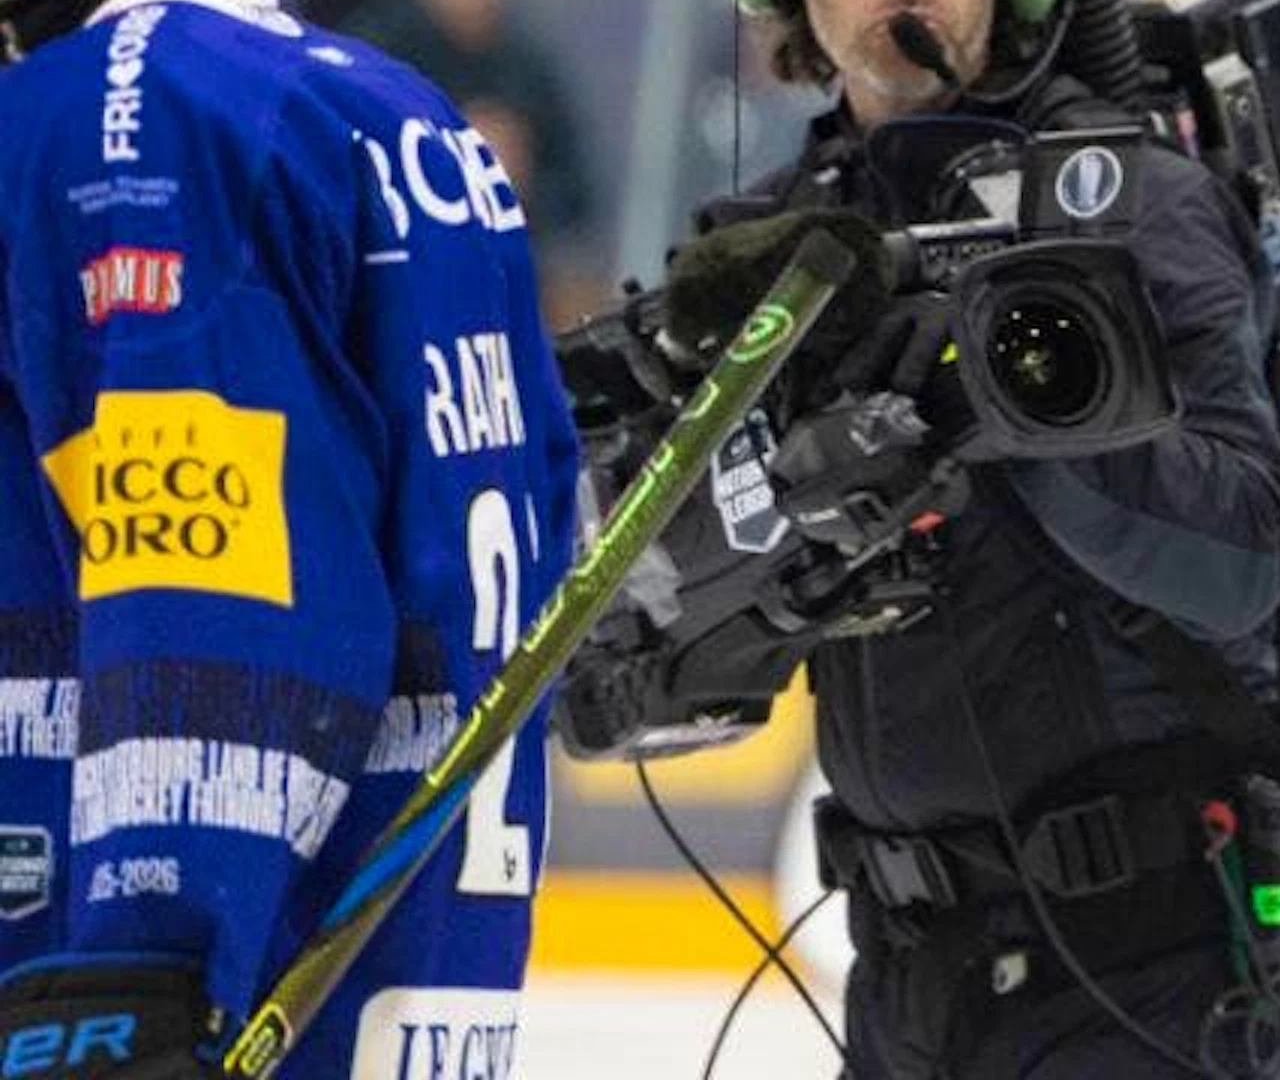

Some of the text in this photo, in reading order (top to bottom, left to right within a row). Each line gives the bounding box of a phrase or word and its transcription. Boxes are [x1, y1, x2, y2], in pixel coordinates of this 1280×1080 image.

[95, 456, 252, 510] ICCO
[84, 512, 230, 565] ORO
[457, 489, 541, 897] 2
